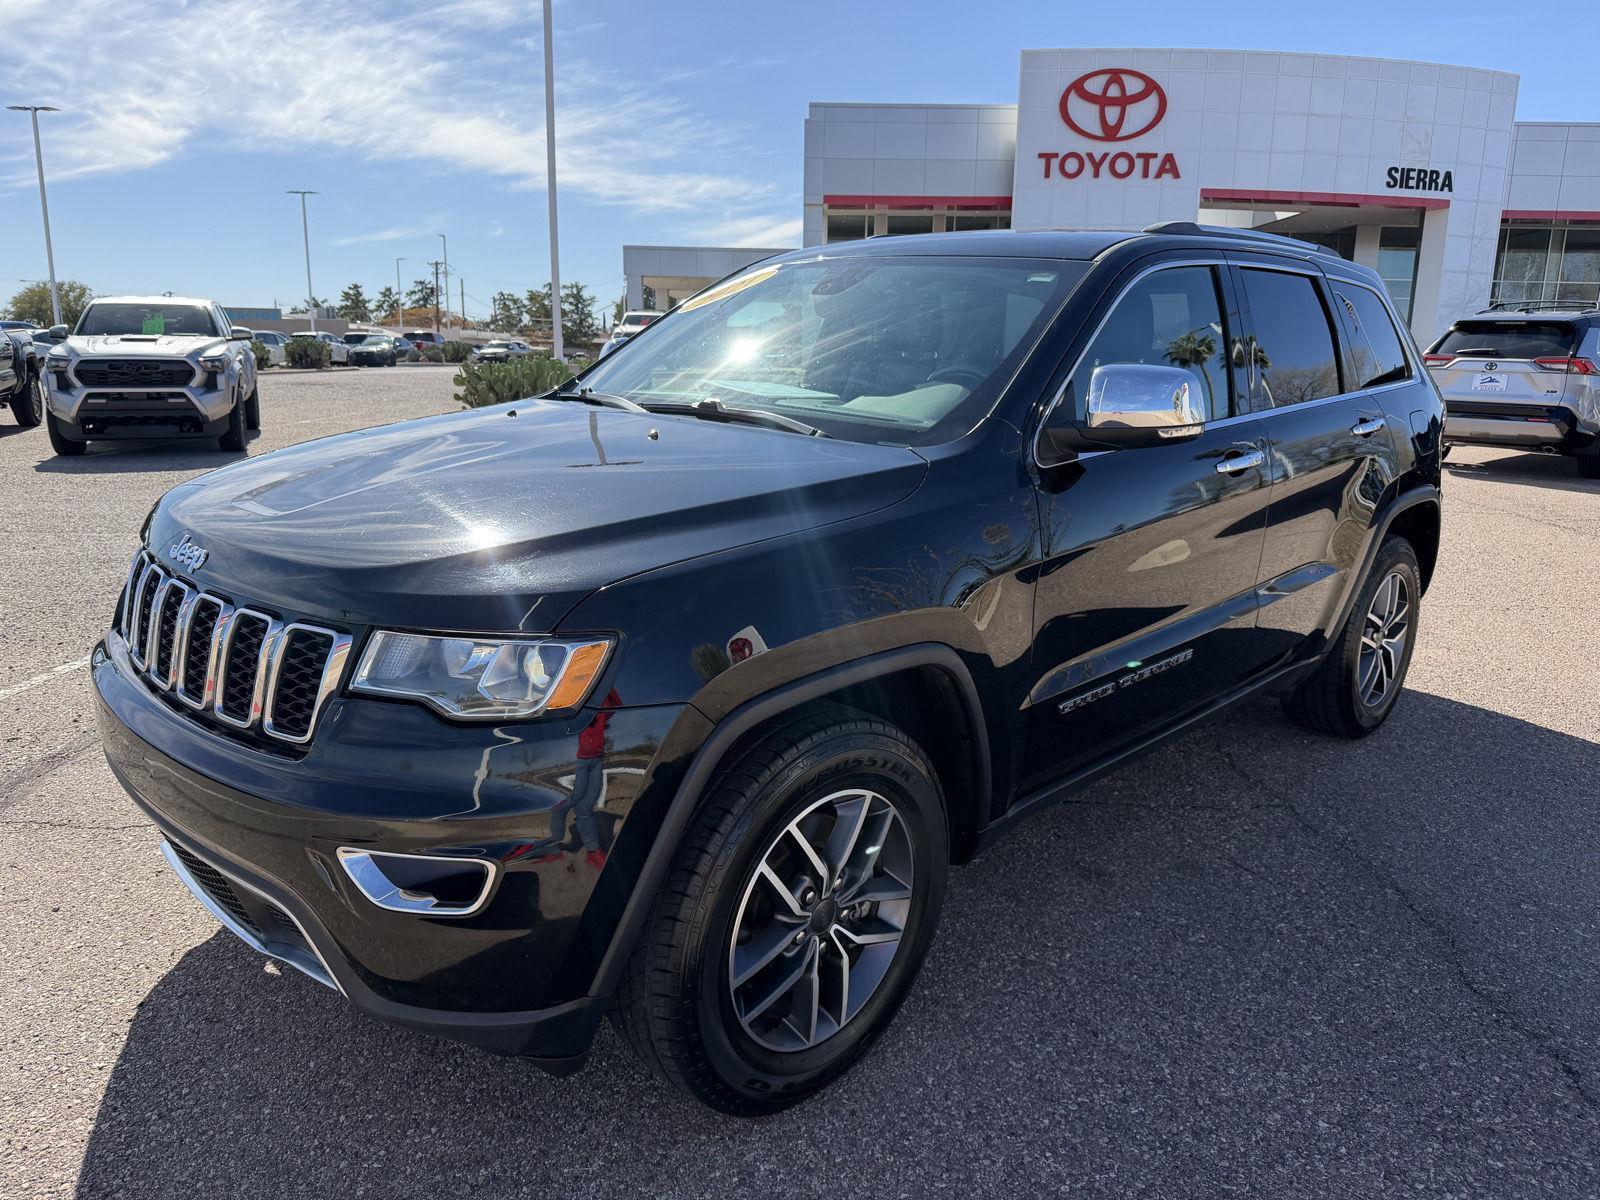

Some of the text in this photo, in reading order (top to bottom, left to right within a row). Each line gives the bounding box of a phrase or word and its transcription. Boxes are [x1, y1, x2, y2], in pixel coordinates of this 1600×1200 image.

[1037, 151, 1181, 180] TOYOTA
[1385, 166, 1454, 193] SIERRA
[169, 534, 209, 574] Jeep
